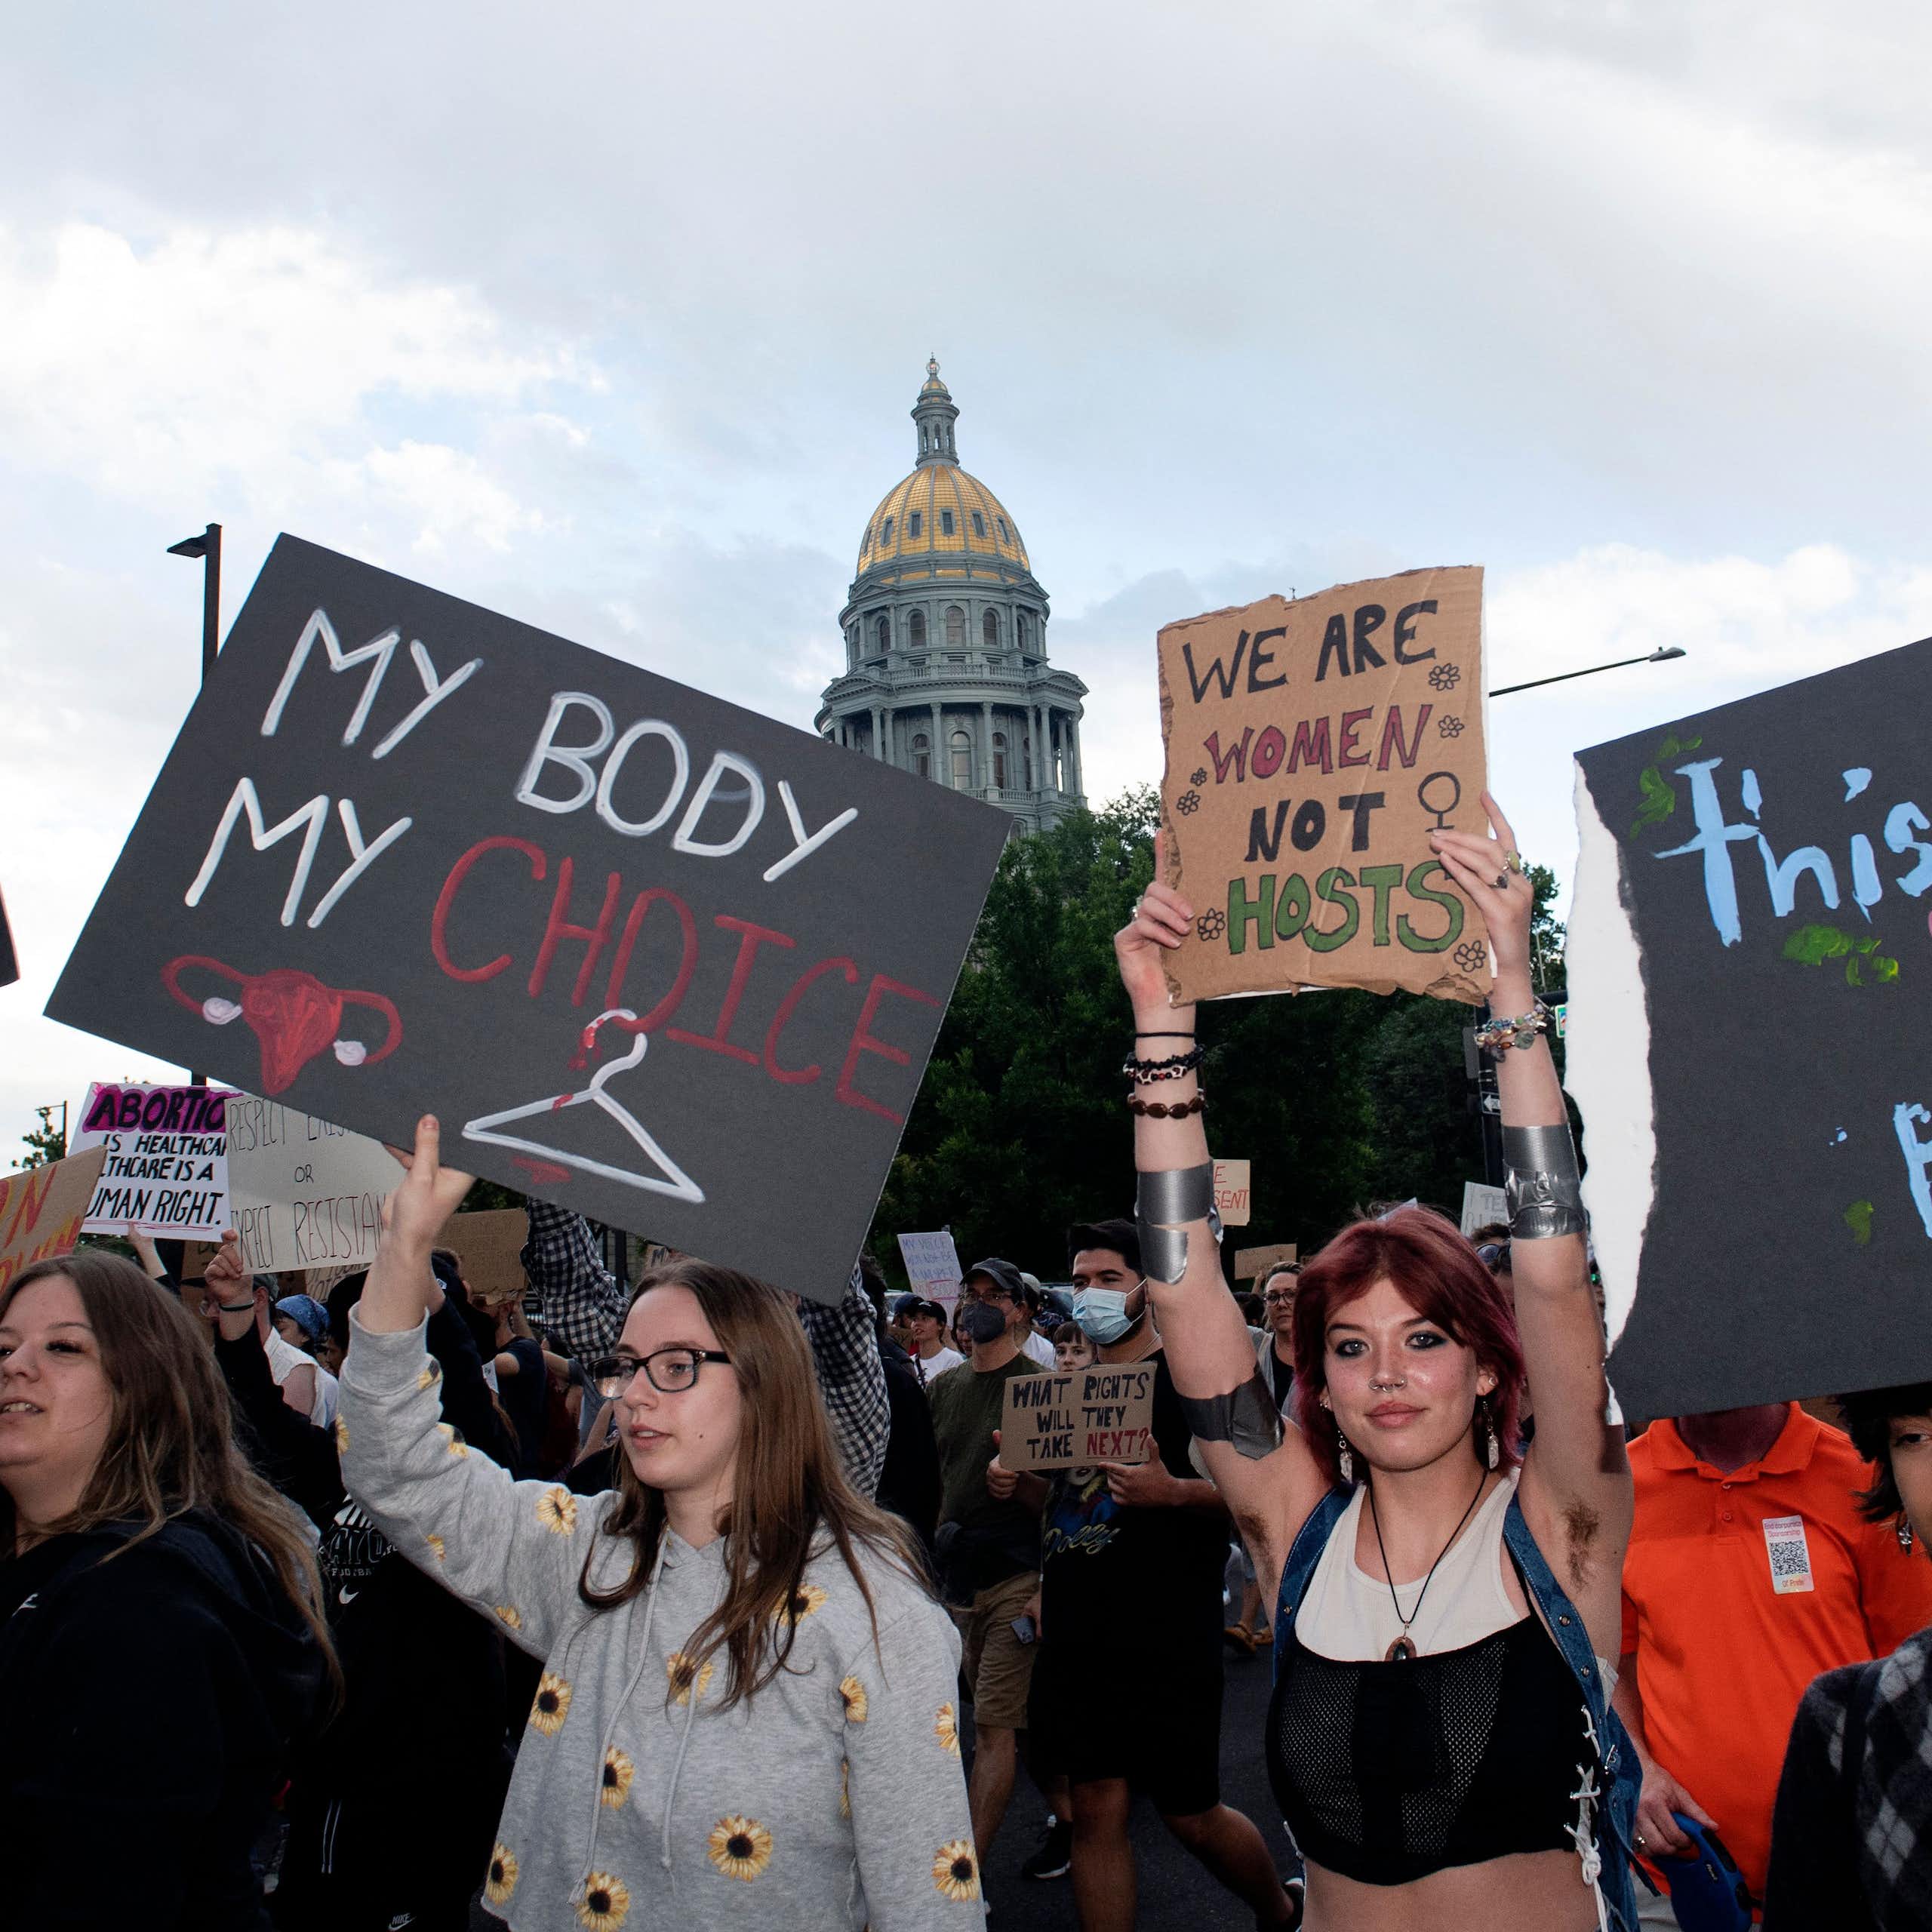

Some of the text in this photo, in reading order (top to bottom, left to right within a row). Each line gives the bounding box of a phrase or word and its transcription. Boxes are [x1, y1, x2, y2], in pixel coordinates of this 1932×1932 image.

[1182, 600, 1438, 704] WE ARE
[260, 608, 859, 882] MY BODY
[1202, 703, 1432, 784] WOMEN
[1244, 791, 1386, 862] NOT
[1226, 859, 1465, 954] HOSTS
[184, 777, 943, 1126] MY CHOICE
[103, 1134, 122, 1152] IS
[99, 1155, 214, 1182] THCARE IS A
[294, 1164, 315, 1184] OR
[152, 1189, 225, 1226] RIGHT.
[1012, 1372, 1151, 1408] WHAT RIGHTS
[1036, 1405, 1128, 1433] WILL THEY
[1026, 1427, 1149, 1460] TAKE NEXT?
[1044, 1523, 1121, 1562] Dolly
